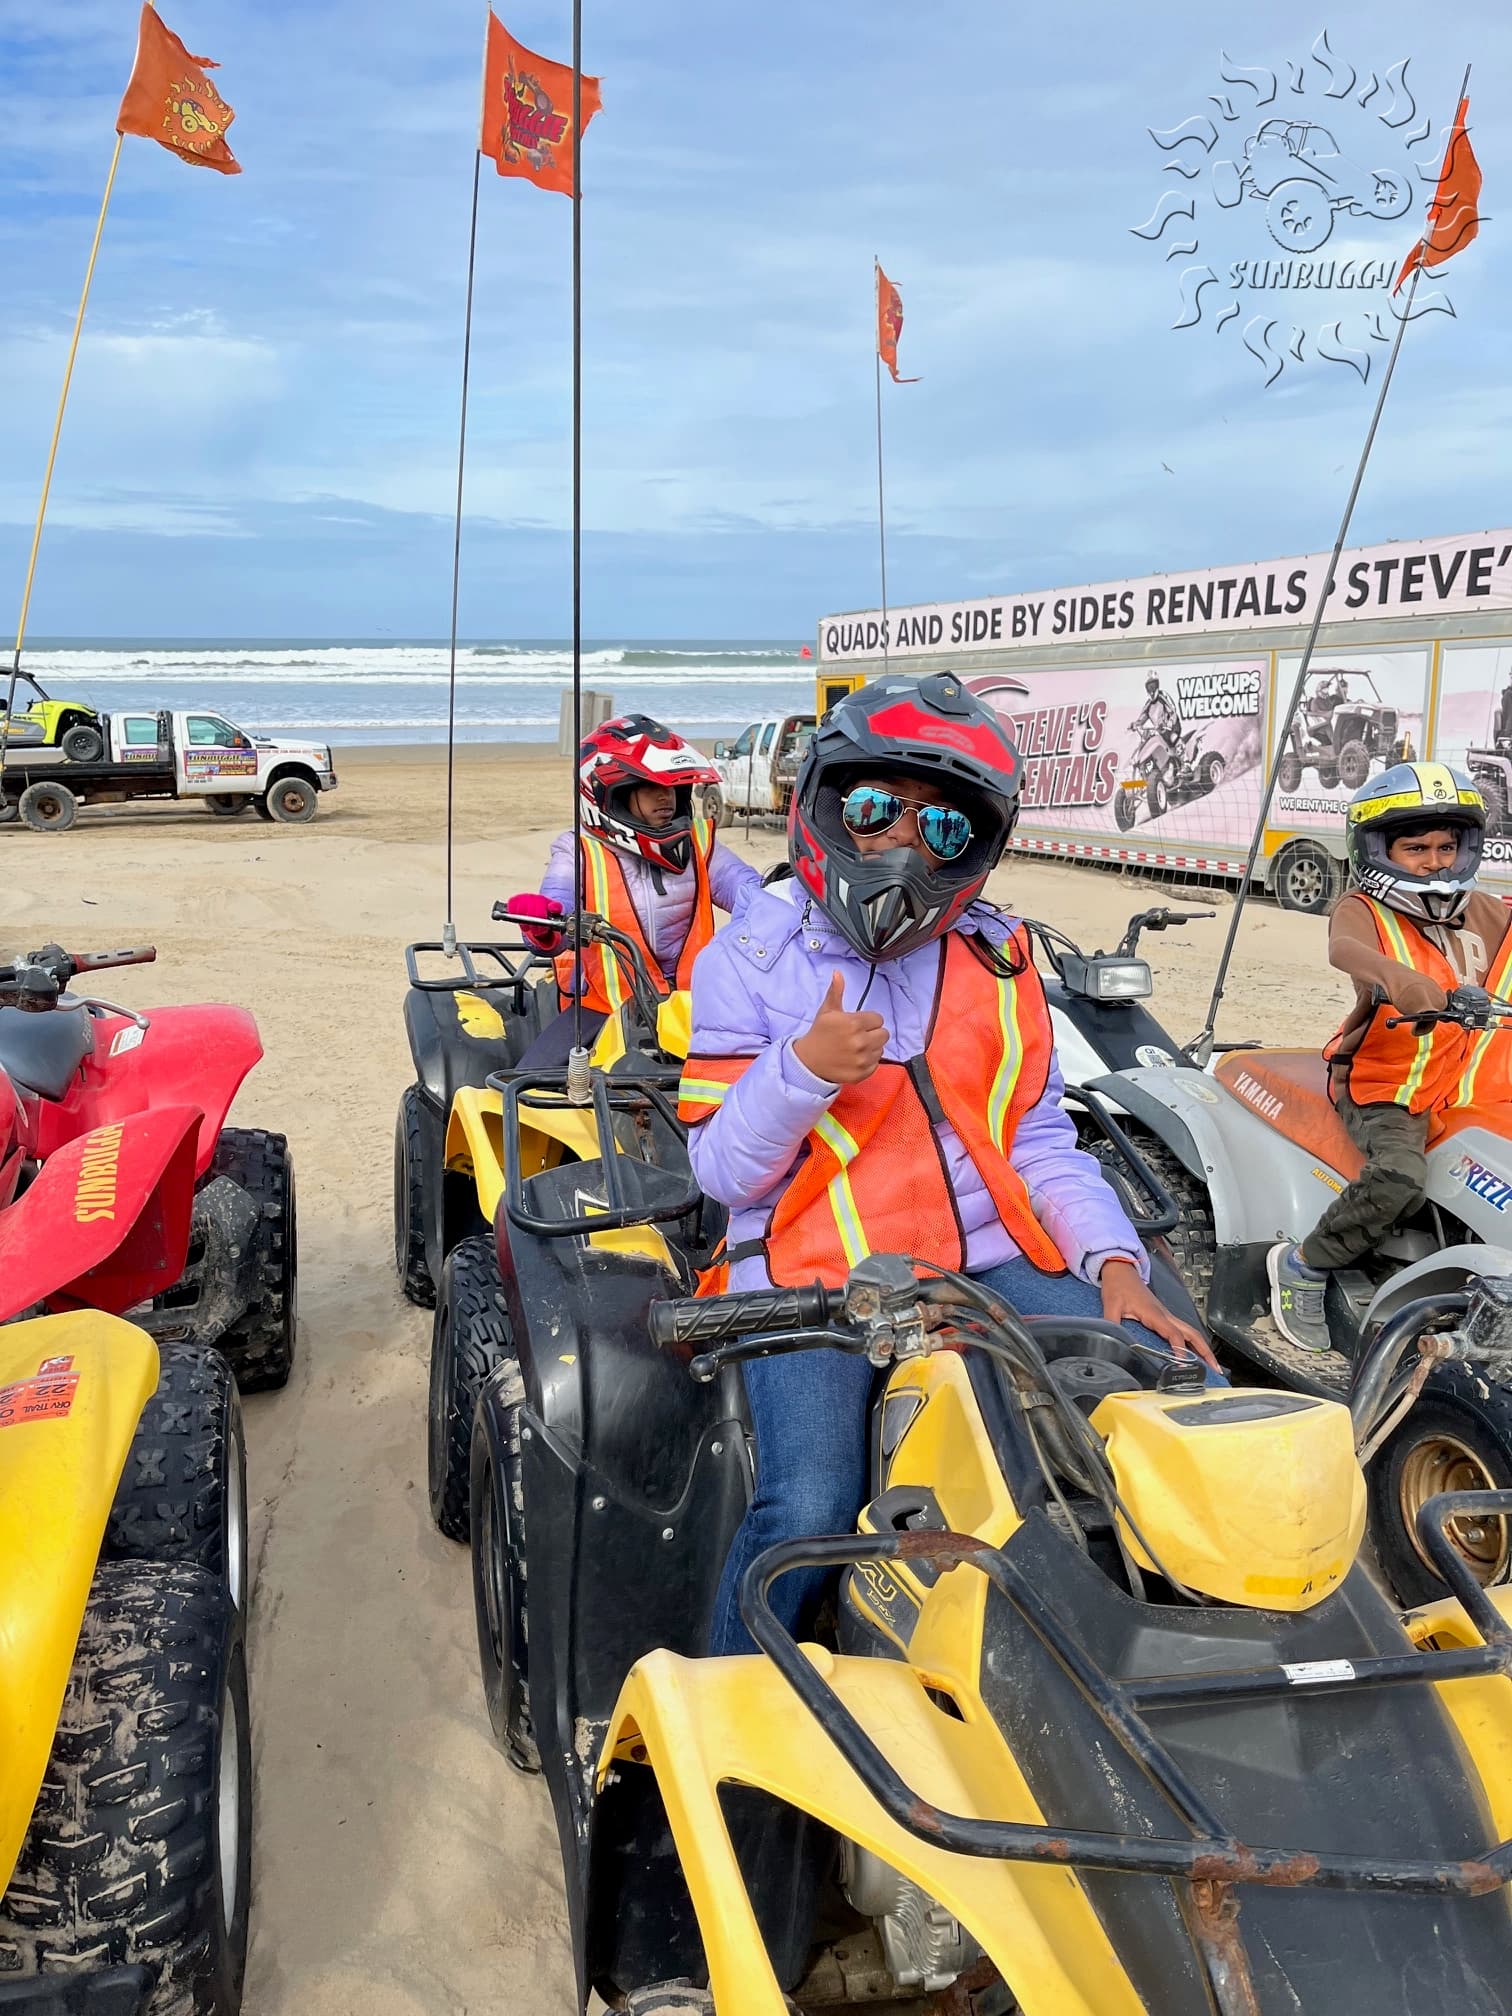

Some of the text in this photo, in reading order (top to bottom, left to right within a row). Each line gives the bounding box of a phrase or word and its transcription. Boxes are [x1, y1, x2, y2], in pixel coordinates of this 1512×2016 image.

[827, 619, 889, 655] QUADS
[896, 615, 943, 647] AND
[951, 607, 1002, 643] SIDE
[1012, 602, 1045, 637] BY
[1052, 591, 1135, 635] SIDES
[1146, 570, 1307, 626] RENTALS
[1178, 672, 1260, 698] WALK-UPS
[1180, 693, 1259, 719] WELCOME
[1020, 752, 1118, 808] ENTALS
[1280, 797, 1295, 810] WE
[1296, 798, 1320, 812] RENT
[1321, 799, 1338, 813] THE
[1233, 1071, 1284, 1120] YAMAHA
[73, 1121, 125, 1222] SUNBUGGY
[1311, 1168, 1344, 1194] AUTOM
